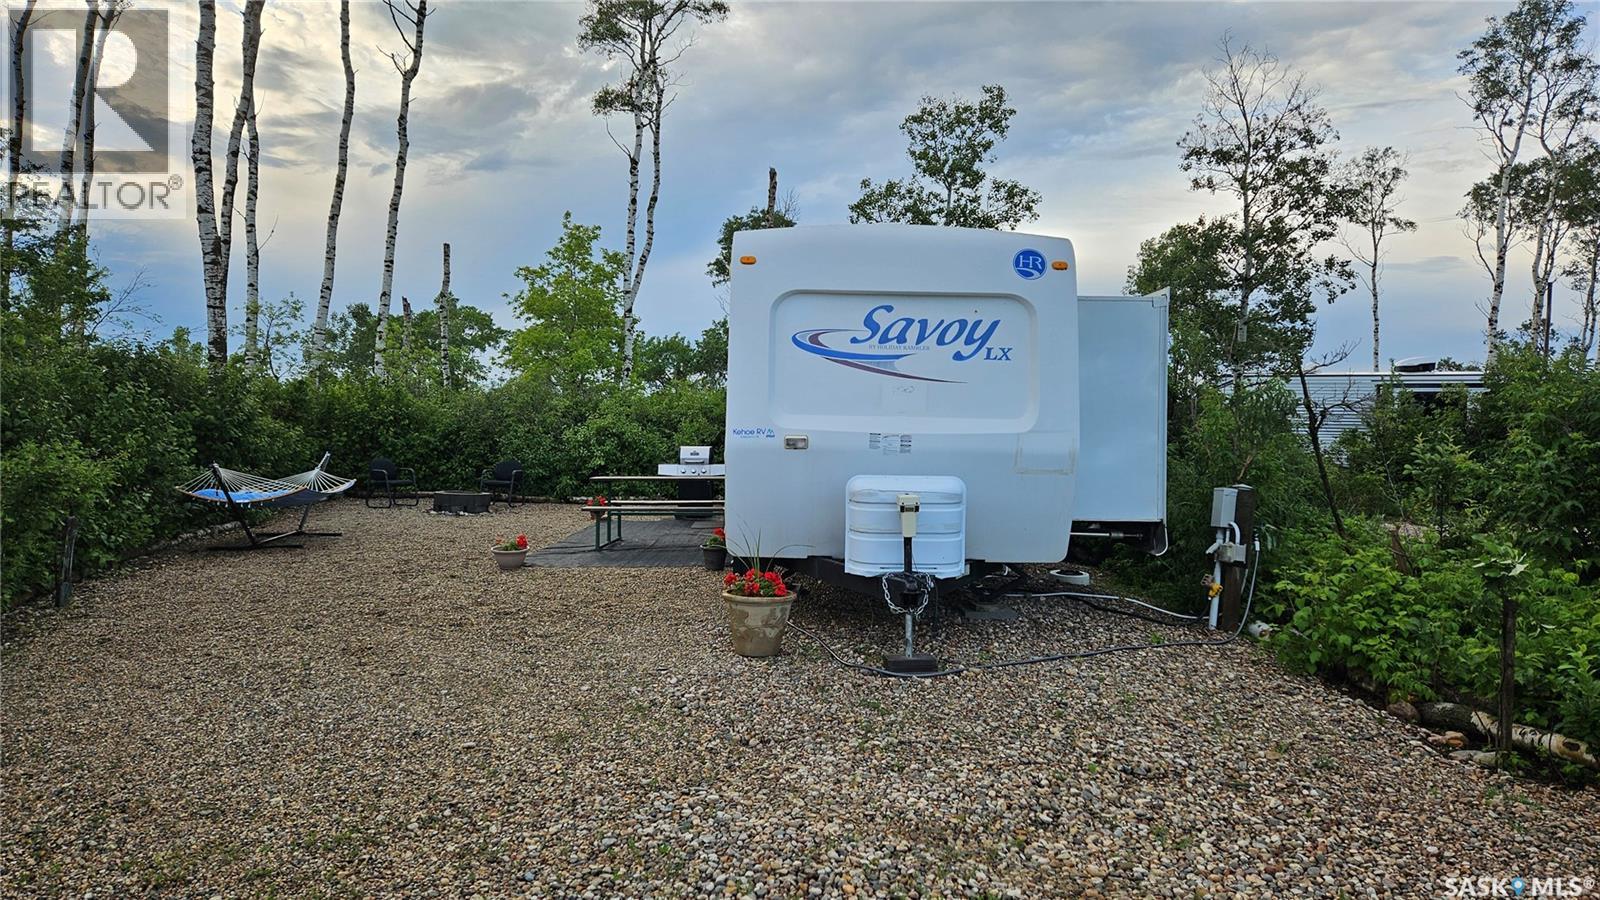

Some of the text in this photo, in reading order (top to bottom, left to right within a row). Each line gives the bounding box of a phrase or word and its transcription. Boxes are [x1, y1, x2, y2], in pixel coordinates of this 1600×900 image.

[1019, 255, 1043, 270] HR
[849, 304, 1001, 361] Savoy
[983, 347, 1013, 361] LX
[756, 427, 767, 435] RV
